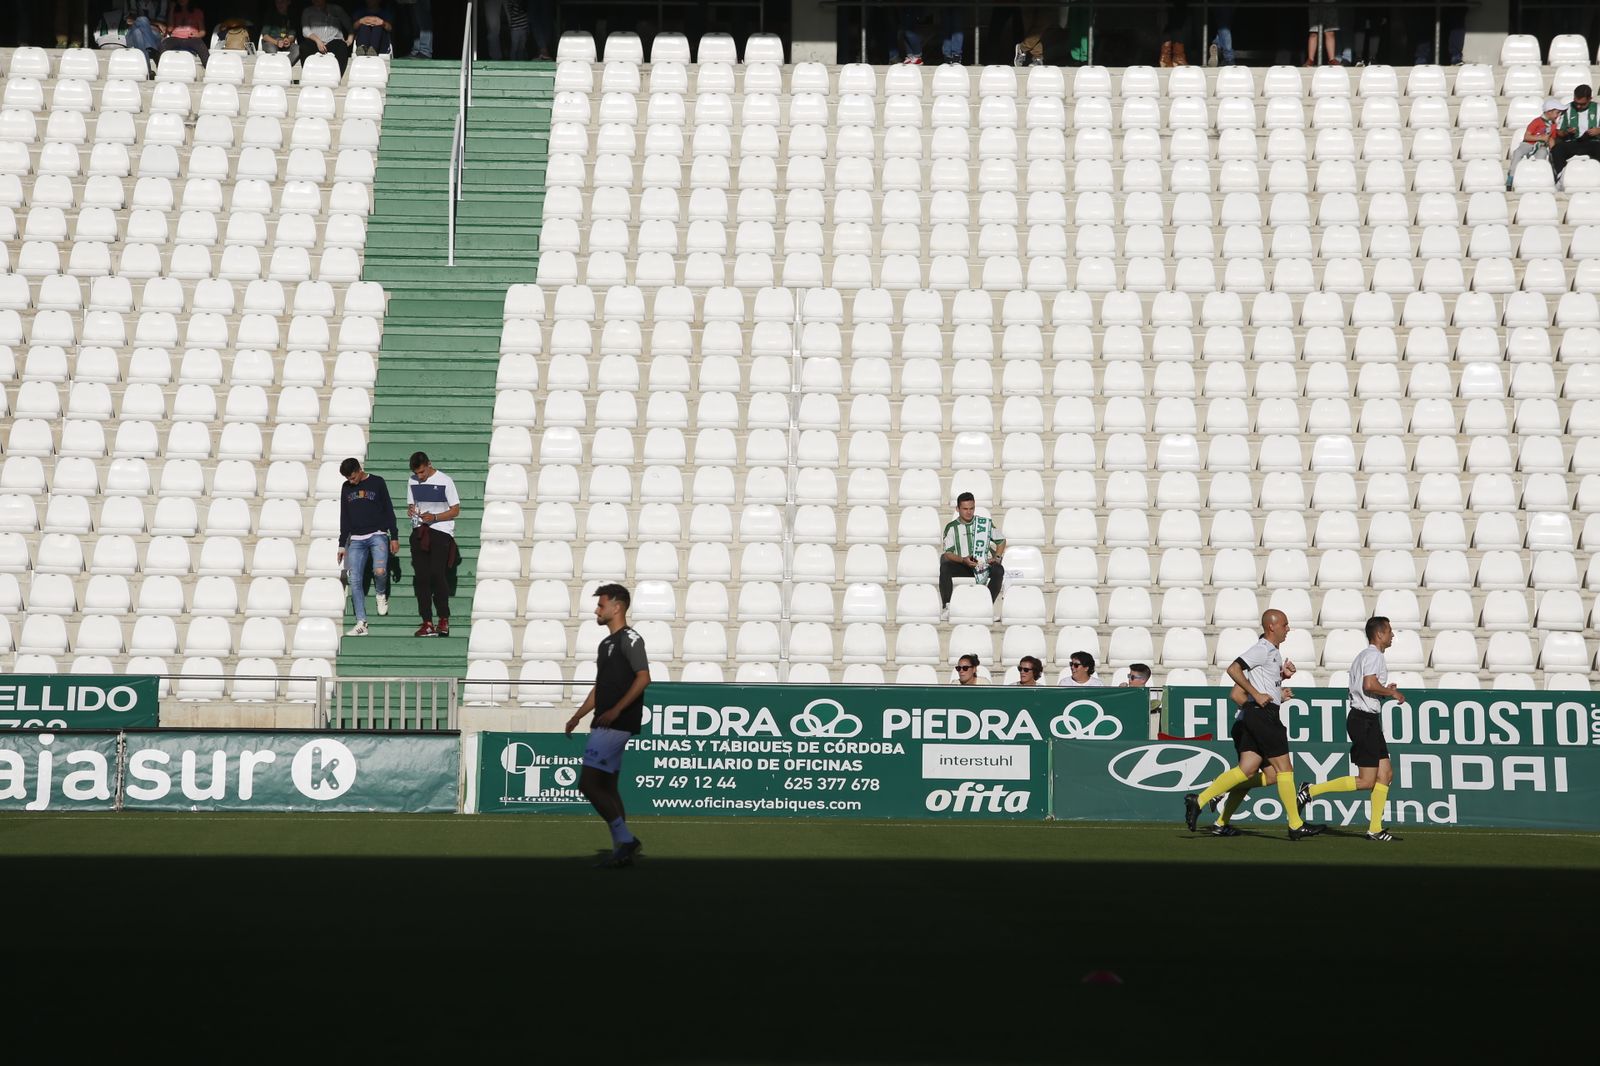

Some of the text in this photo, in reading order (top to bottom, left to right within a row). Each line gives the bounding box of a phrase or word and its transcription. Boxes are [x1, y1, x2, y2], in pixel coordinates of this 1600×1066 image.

[624, 739, 905, 754] FICINAS Y TABIQUES DE CÓRDOBA
[654, 757, 863, 771] MOBILIARIO DE OFICINAS
[939, 754, 1014, 767] interstuhl
[635, 775, 737, 789] 957 49 12 44
[784, 777, 880, 791] 625 377 678
[925, 781, 1031, 813] ofita
[652, 797, 862, 812] www.oficinasytabiques.com
